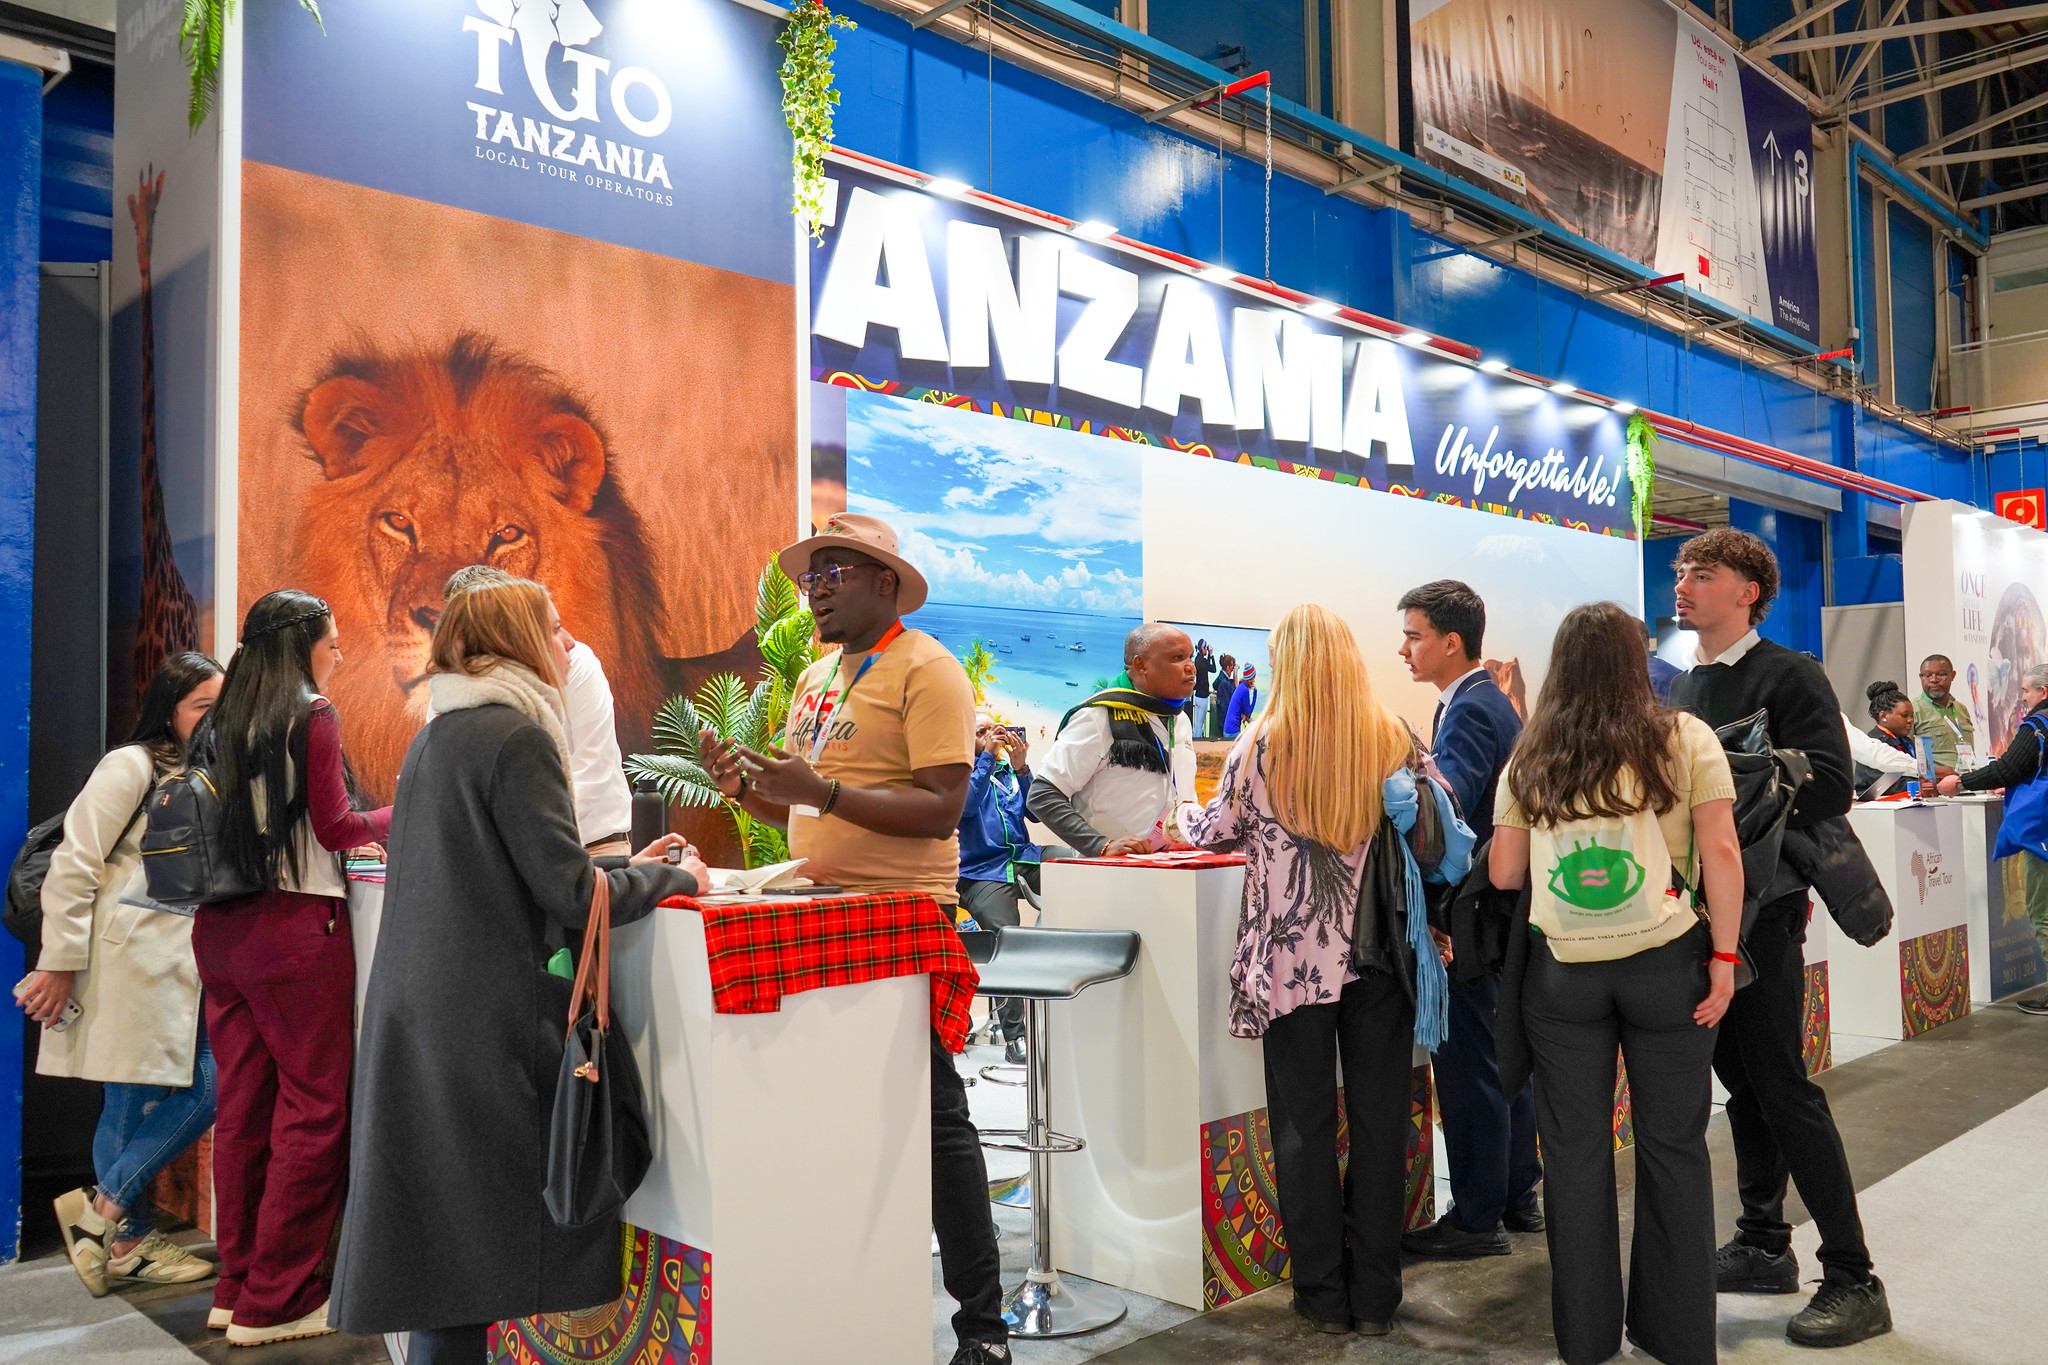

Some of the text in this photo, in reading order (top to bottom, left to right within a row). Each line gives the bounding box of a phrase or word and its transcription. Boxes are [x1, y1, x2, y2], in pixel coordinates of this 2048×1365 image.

[1696, 50, 1723, 78] You are in
[1718, 55, 1726, 67] en
[1702, 73, 1714, 91] Hall
[466, 101, 673, 190] TANZANIA
[475, 146, 673, 207] LOCAL TOUR OPERATORS
[1795, 150, 1809, 197] 3
[1752, 294, 1758, 303] 12
[1779, 295, 1800, 314] América
[1779, 307, 1789, 321] The
[1435, 423, 1622, 507] Unforgettable!
[1961, 570, 1987, 598] ONCE
[1963, 608, 1984, 632] LIFE
[808, 742, 848, 751] SARIS
[1927, 853, 1942, 864] African
[1928, 871, 1952, 888] Travel Tour
